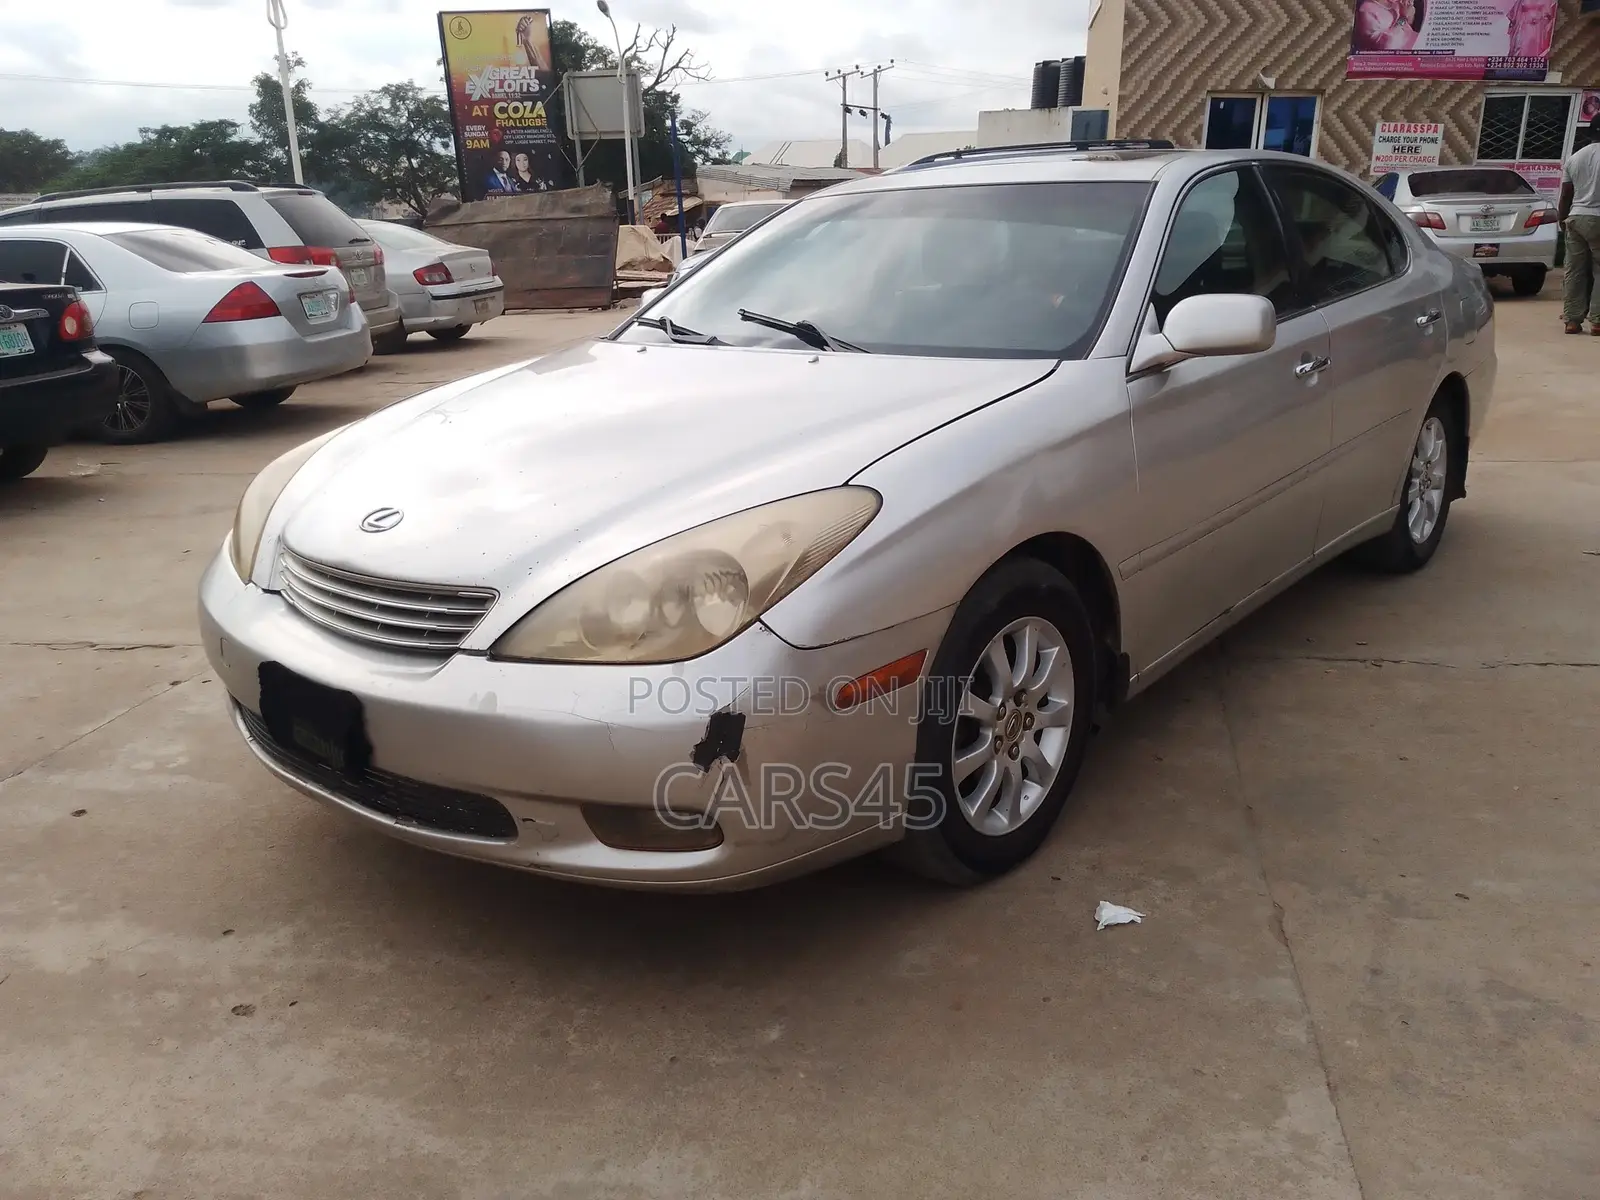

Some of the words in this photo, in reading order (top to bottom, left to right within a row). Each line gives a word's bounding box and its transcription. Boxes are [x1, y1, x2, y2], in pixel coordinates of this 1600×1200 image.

[488, 66, 539, 80] GREAT
[472, 105, 489, 116] AT
[493, 101, 547, 119] COZA
[496, 119, 515, 127] FHA
[516, 119, 547, 127] LUGBE
[1381, 123, 1439, 134] CLARASSPA
[466, 139, 490, 149] 9AM
[1378, 135, 1401, 143] CHARGE
[1403, 136, 1418, 144] YOUR
[1419, 136, 1439, 144] PHONE
[1393, 145, 1420, 154] HERE
[1394, 155, 1408, 163] PER
[1409, 155, 1436, 163] CHARGE
